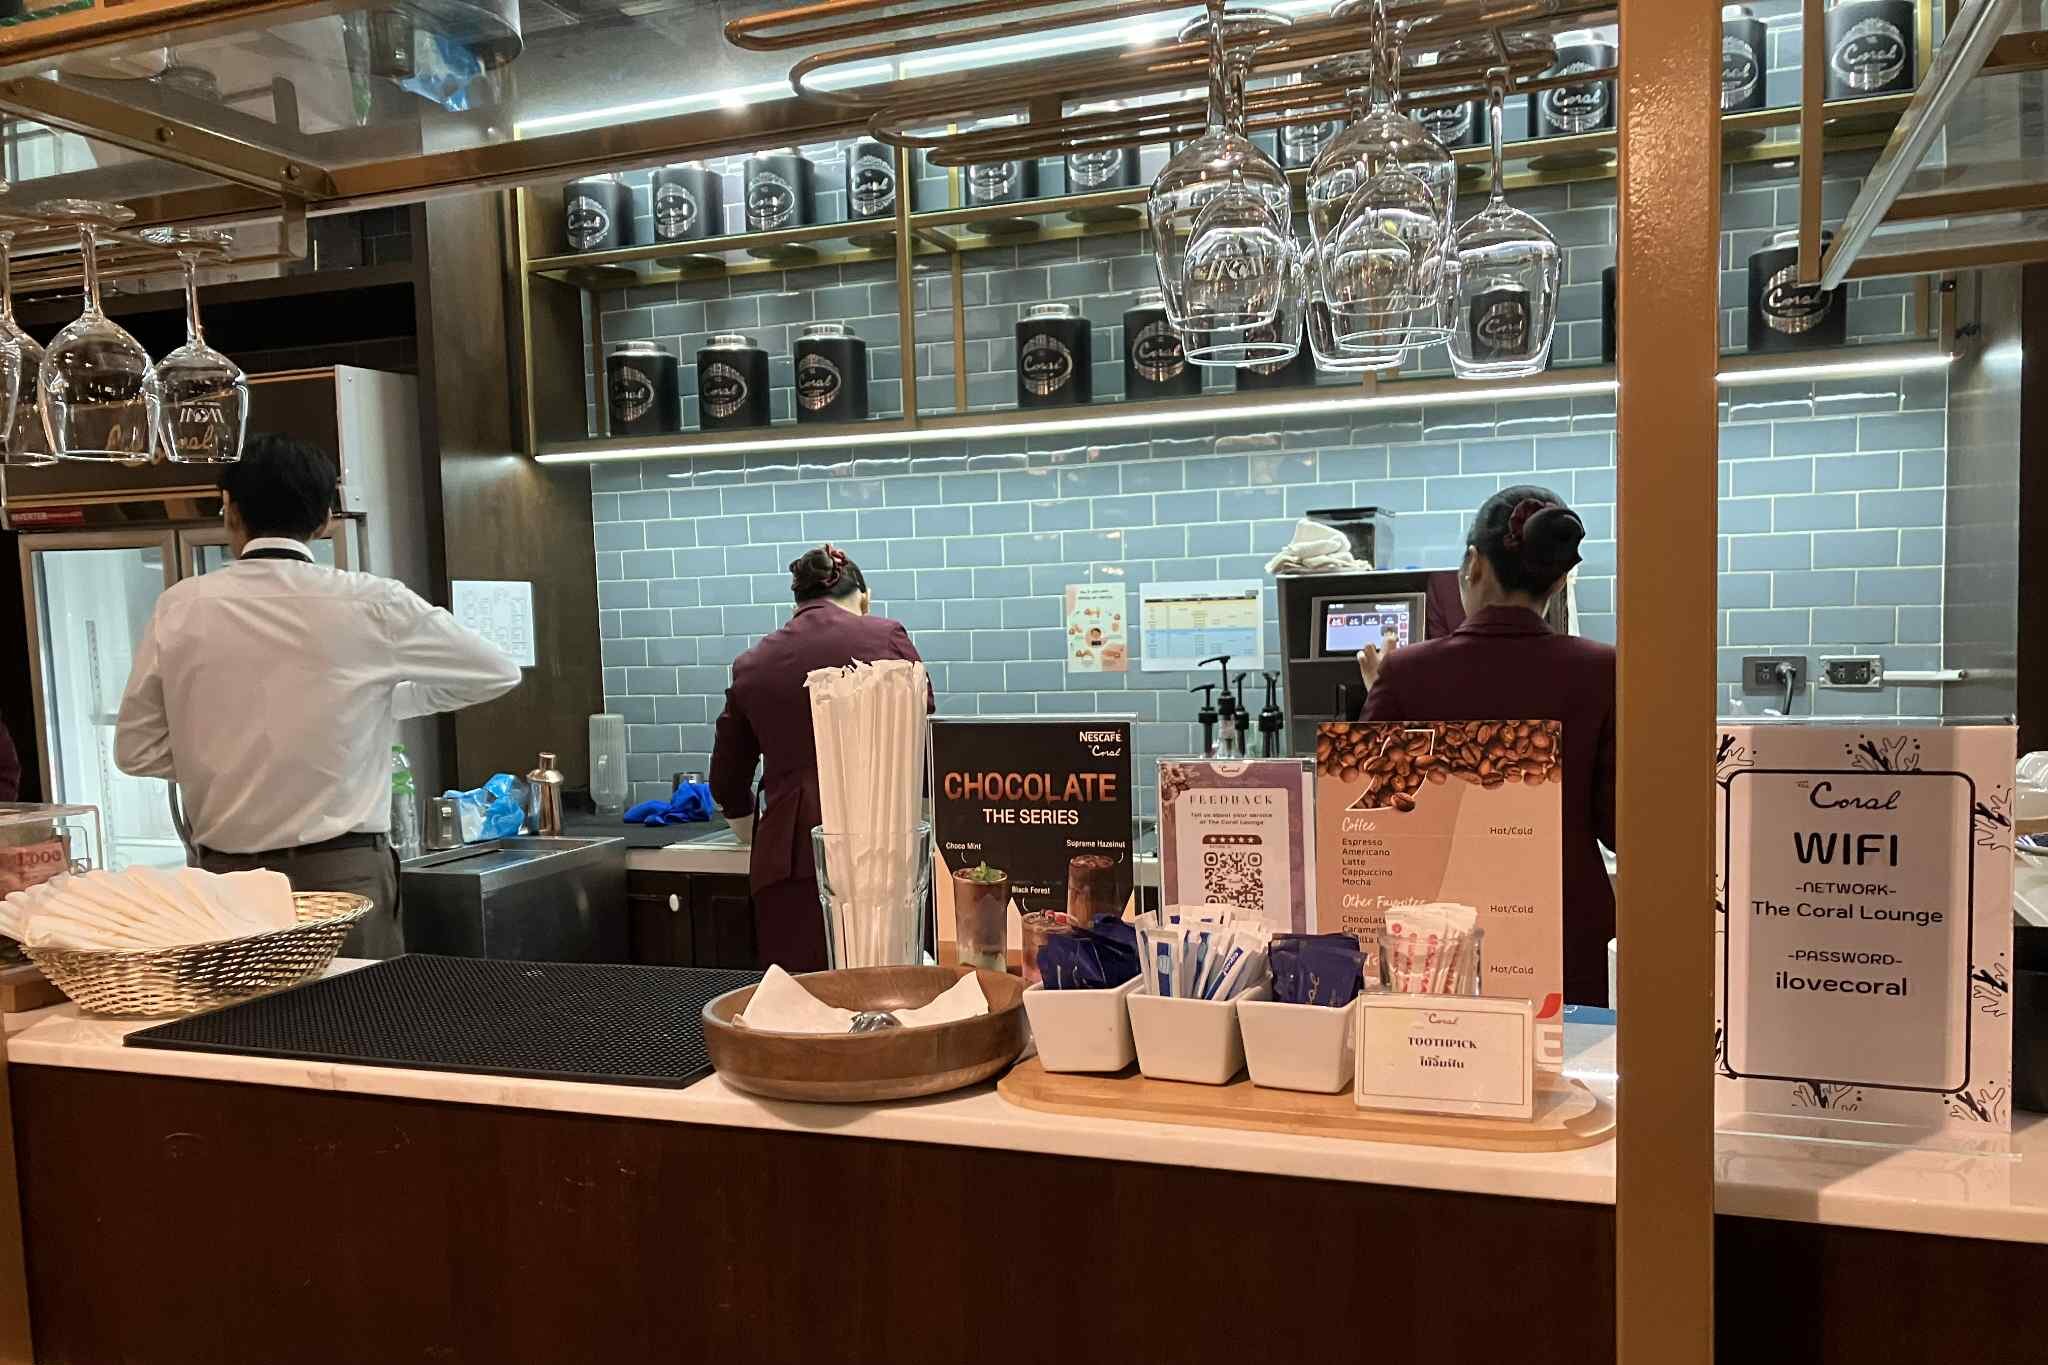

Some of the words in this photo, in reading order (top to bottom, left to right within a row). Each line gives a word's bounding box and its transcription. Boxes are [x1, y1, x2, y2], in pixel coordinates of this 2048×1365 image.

[1843, 42, 1898, 64] Coral
[1552, 86, 1601, 106] Coral
[1416, 103, 1461, 120] Coral
[1023, 356, 1063, 372] Coral
[1092, 745, 1121, 757] Coral
[944, 772, 1117, 801] CHOCOLATE
[1190, 795, 1273, 805] FEEDBACK
[1809, 781, 1902, 810] Coral
[982, 808, 1015, 824] THE
[1019, 809, 1079, 825] SERIES
[1342, 817, 1376, 832] Coffee
[1489, 826, 1534, 836] Hot/Cold
[945, 841, 966, 850] Choco
[966, 842, 982, 850] Mint
[1066, 839, 1096, 848] Supreme
[1097, 840, 1126, 848] Hazelnut
[1342, 838, 1383, 847] Espresso
[1794, 831, 1898, 867] WIFI
[1342, 848, 1391, 856] Americano
[1342, 858, 1366, 866] Latte
[1342, 868, 1393, 877] Cappuccino
[1342, 878, 1372, 886] Mocha
[1011, 885, 1029, 894] Black
[1030, 886, 1051, 895] Forest
[1342, 893, 1373, 908] Other
[1490, 904, 1534, 914] Hot/Cold
[1751, 900, 1790, 916] The
[1796, 902, 1853, 919] Coral
[1860, 905, 1944, 927] Lounge
[1490, 965, 1534, 975] Hot/Cold
[1775, 971, 1908, 996] ilovecoral
[1428, 1012, 1459, 1025] Coral
[1408, 1036, 1479, 1049] TOOTHPICK
